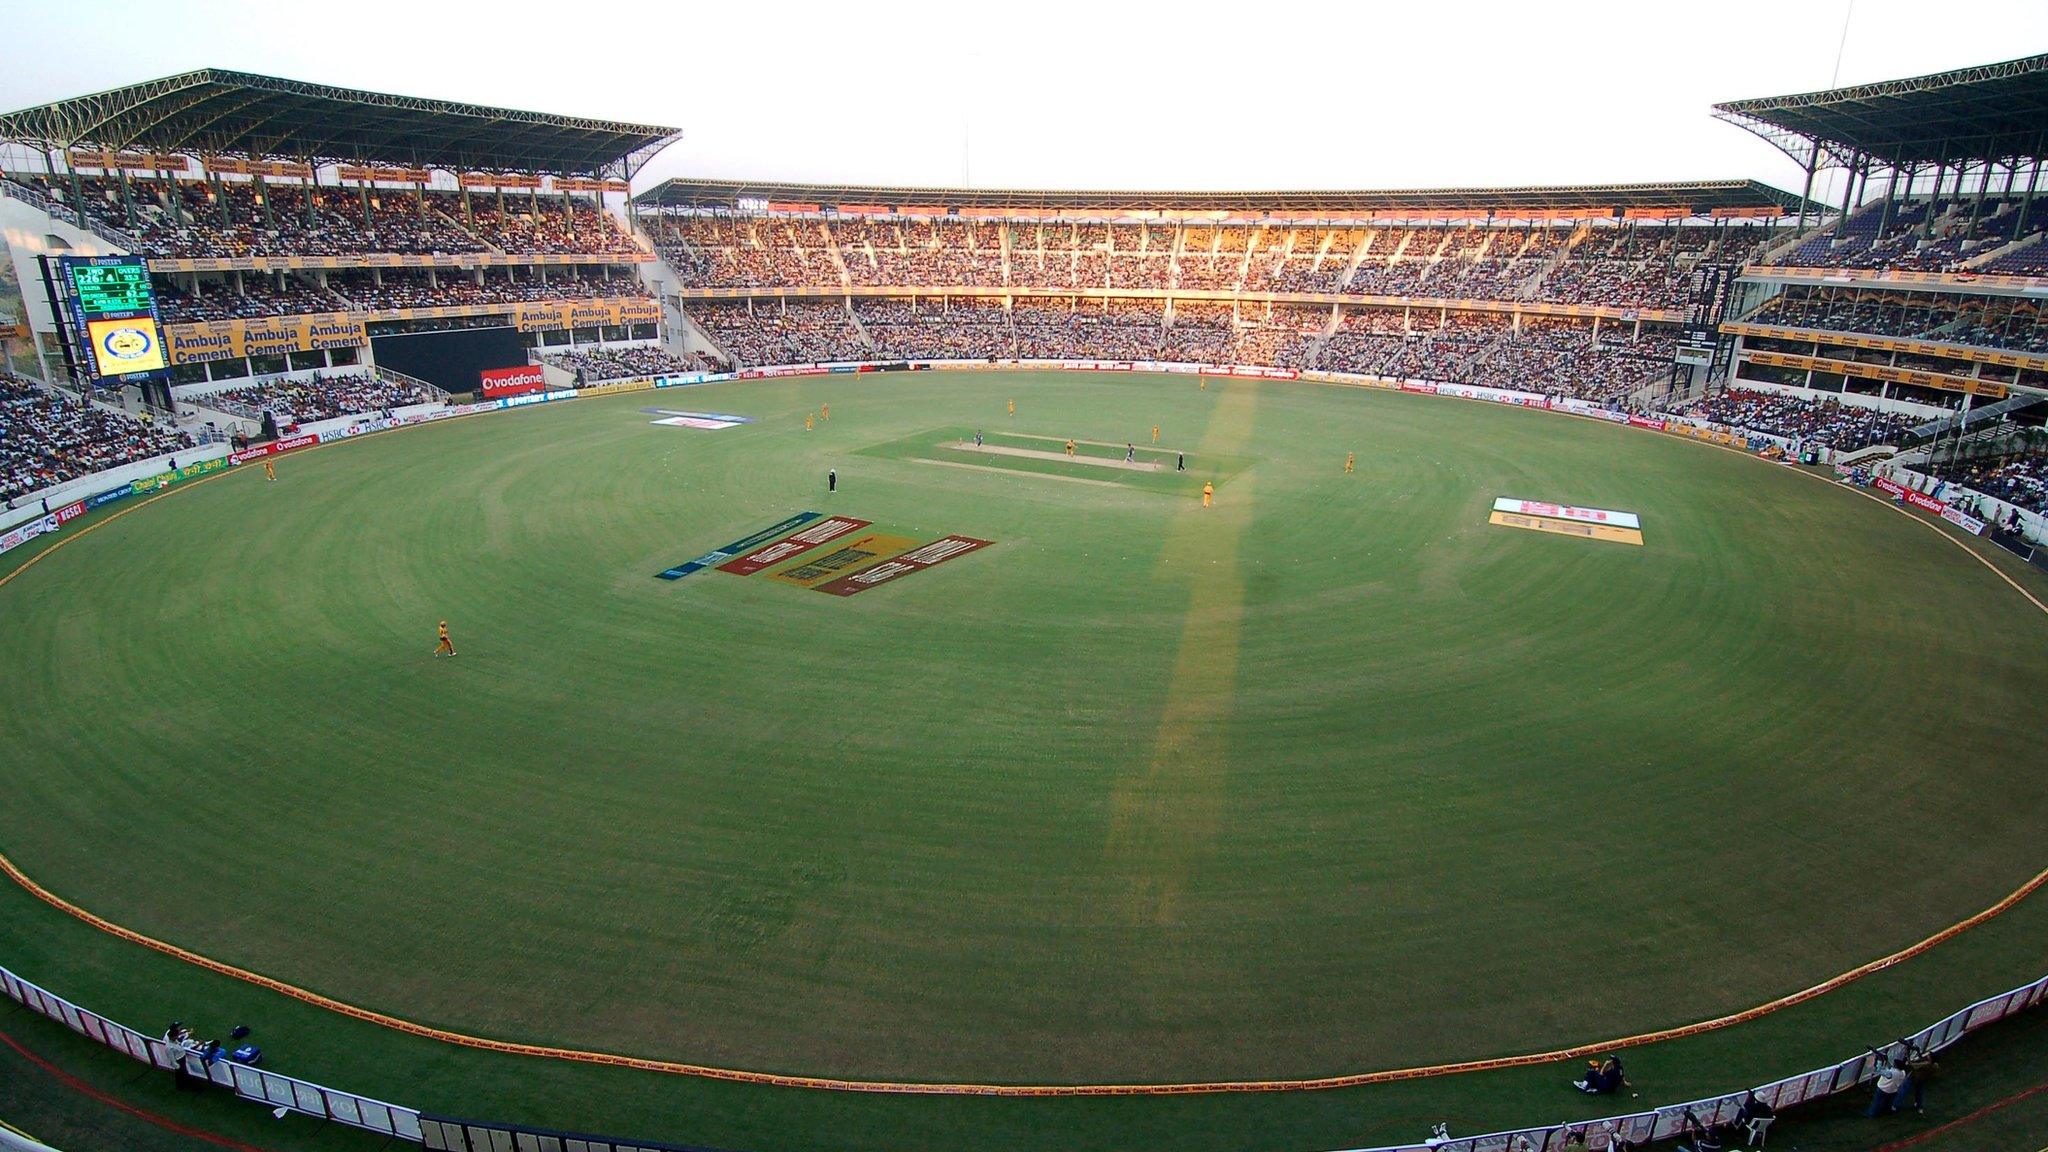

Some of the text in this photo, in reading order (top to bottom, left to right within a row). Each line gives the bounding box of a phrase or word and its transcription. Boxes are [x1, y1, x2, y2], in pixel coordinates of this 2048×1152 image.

[522, 310, 562, 321] Ambuja
[571, 307, 611, 318] Ambuja
[620, 305, 658, 315] Ambuja
[571, 318, 612, 328] Cement
[620, 315, 659, 325] Cement
[310, 323, 361, 336] Ambuja
[522, 321, 564, 332] Cement
[174, 333, 232, 349] Ambuja
[244, 328, 298, 342] Ambuja
[244, 341, 300, 356] Cement
[310, 336, 364, 349] Cement
[176, 347, 234, 363] Cement
[493, 372, 542, 387] vodafone
[364, 420, 388, 431] HSBC
[321, 428, 346, 441] HSBC
[283, 437, 313, 449] vodafone
[239, 448, 268, 460] vodafone
[1914, 496, 1942, 512] vodafone
